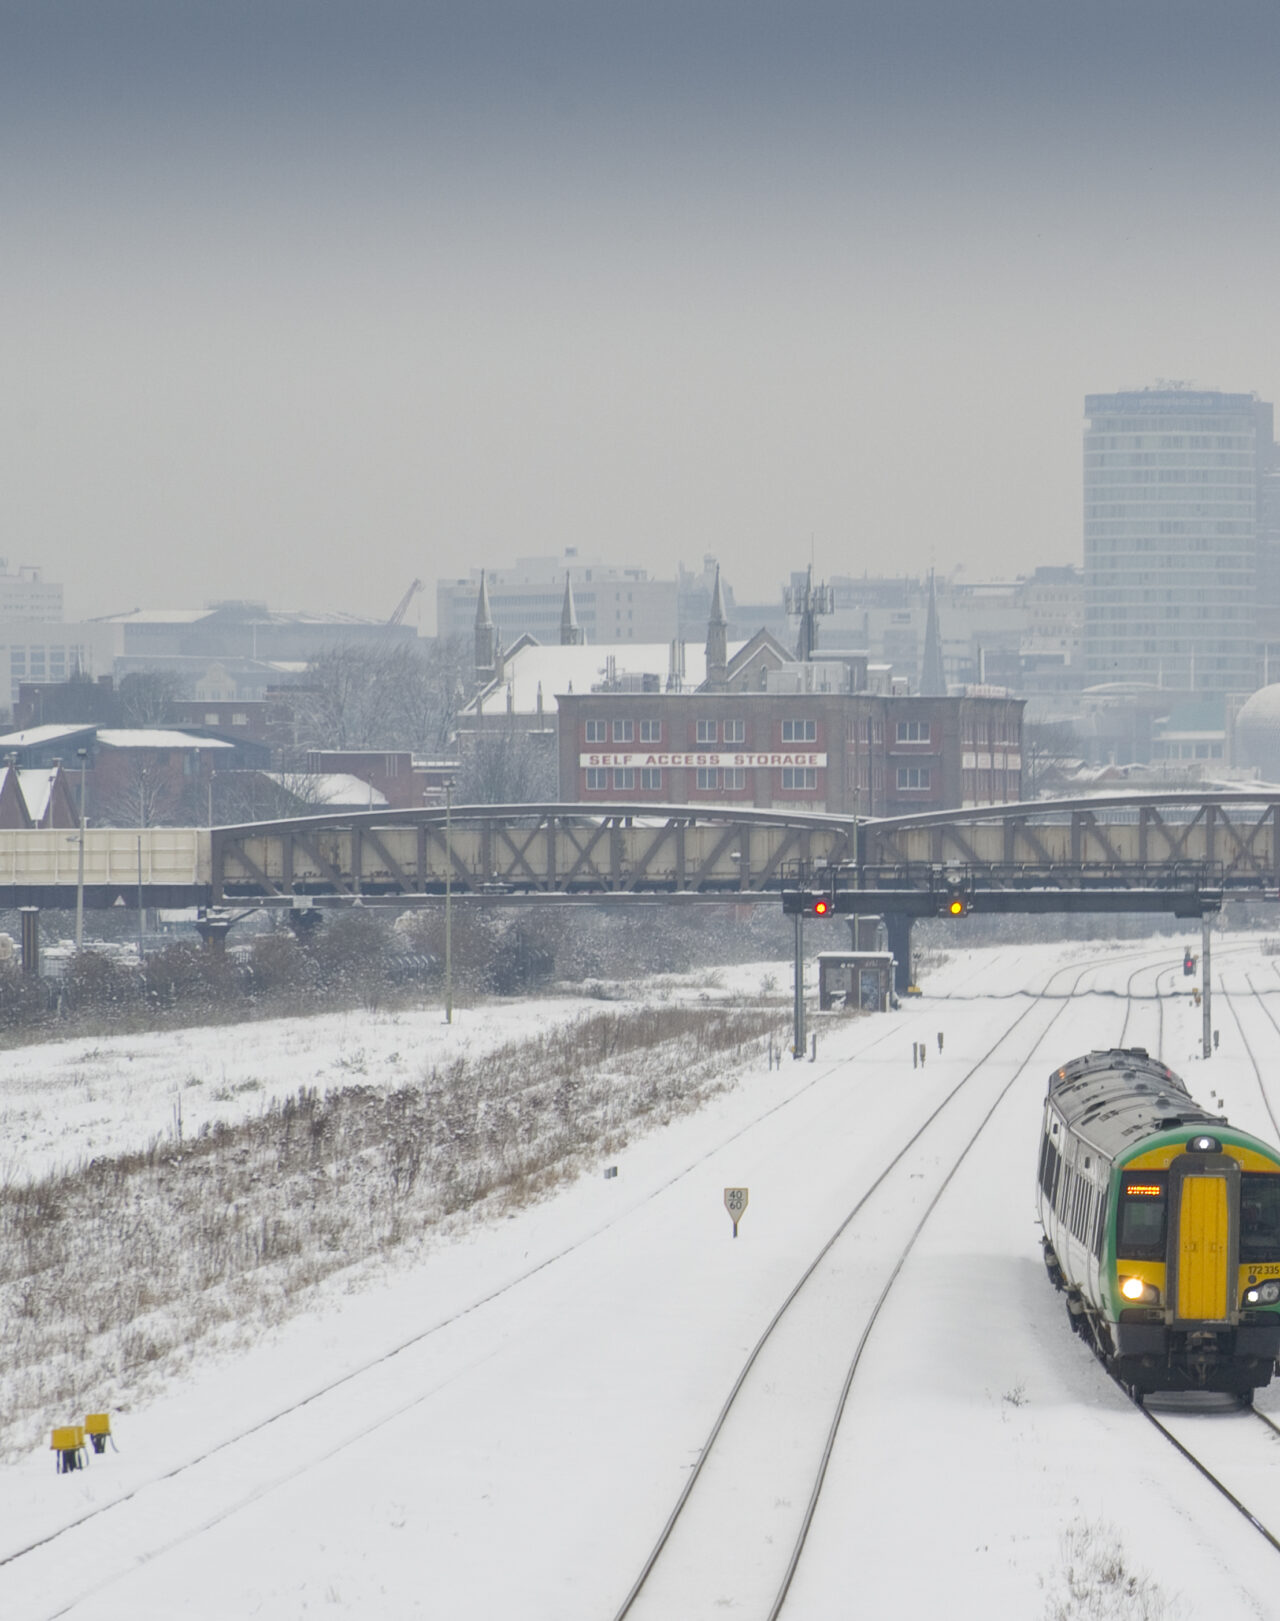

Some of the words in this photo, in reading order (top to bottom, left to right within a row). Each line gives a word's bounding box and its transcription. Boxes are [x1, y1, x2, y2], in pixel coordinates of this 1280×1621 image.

[589, 755, 632, 765] SELF
[645, 755, 720, 765] ACCESS
[734, 755, 818, 765] STORAGE
[729, 1190, 743, 1200] 40
[729, 1201, 743, 1210] 60
[1248, 1265, 1263, 1275] 172
[1264, 1265, 1280, 1275] 335
